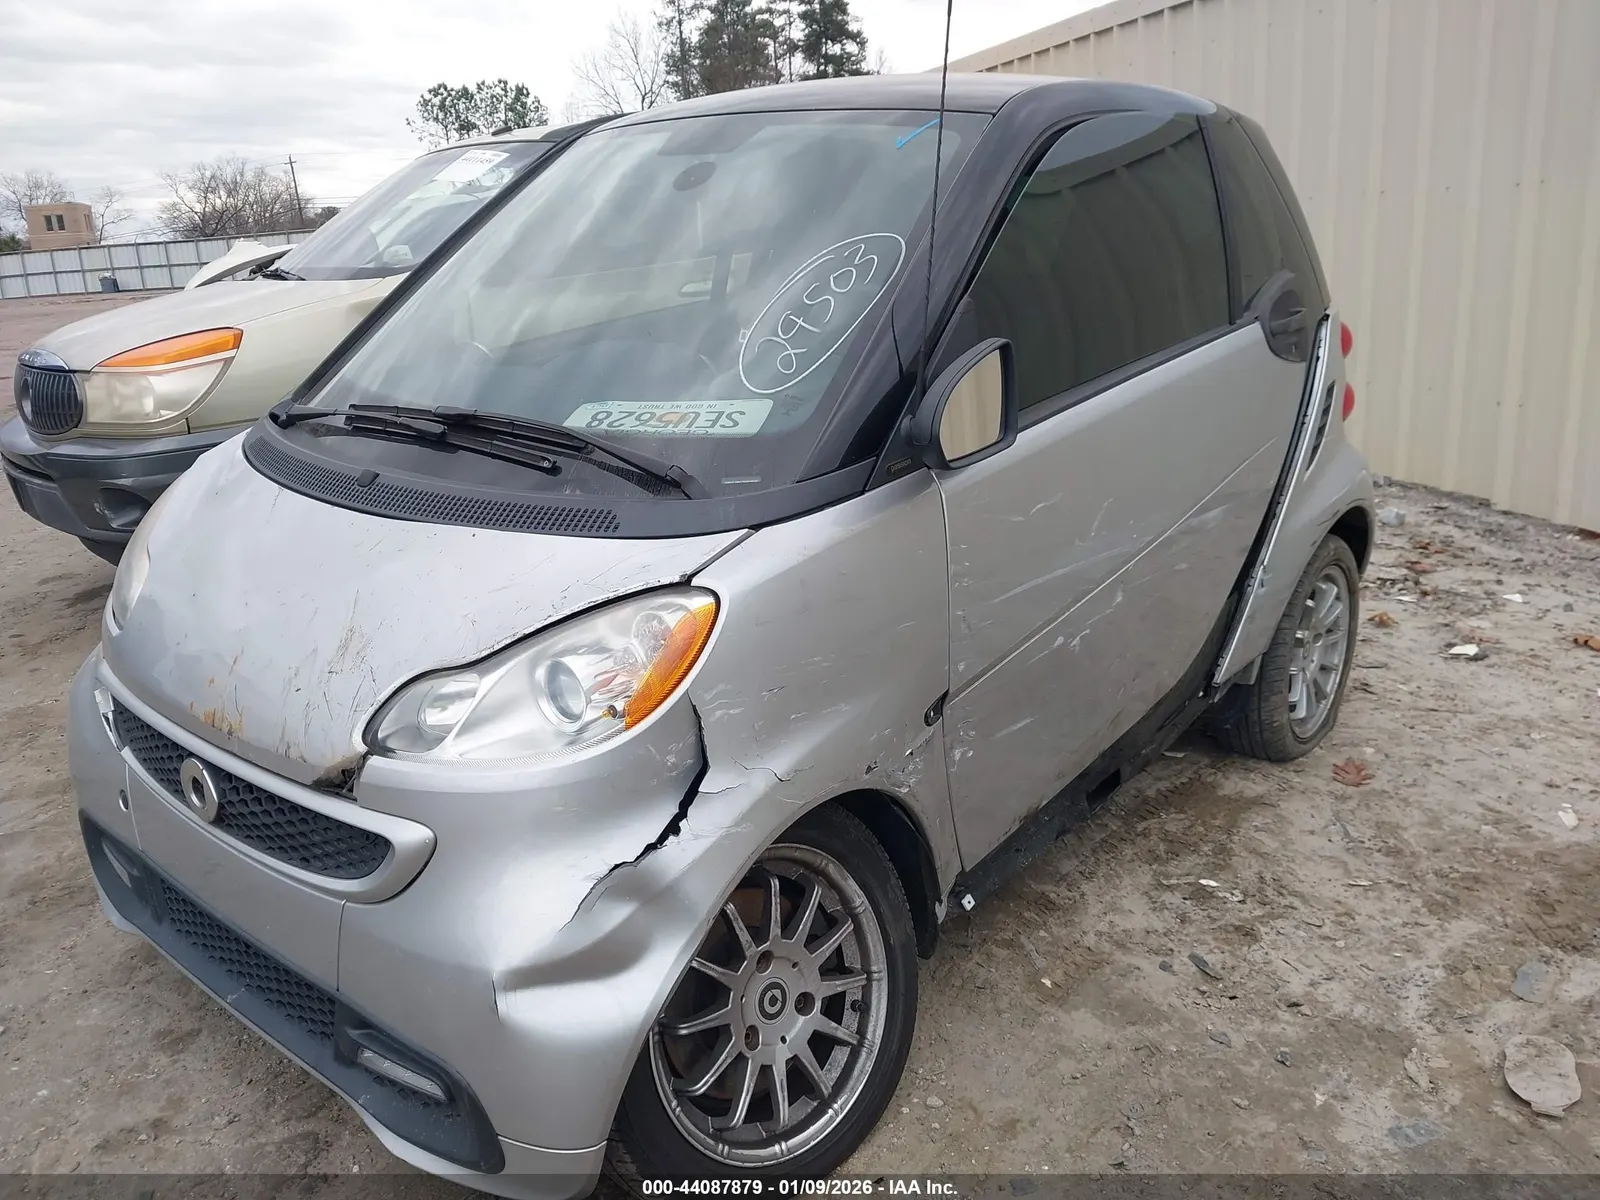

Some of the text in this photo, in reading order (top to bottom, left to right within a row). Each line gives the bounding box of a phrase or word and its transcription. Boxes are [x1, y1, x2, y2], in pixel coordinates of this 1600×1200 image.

[755, 243, 878, 374] 29503
[585, 410, 746, 429] SEU5628
[890, 458, 912, 474] passion
